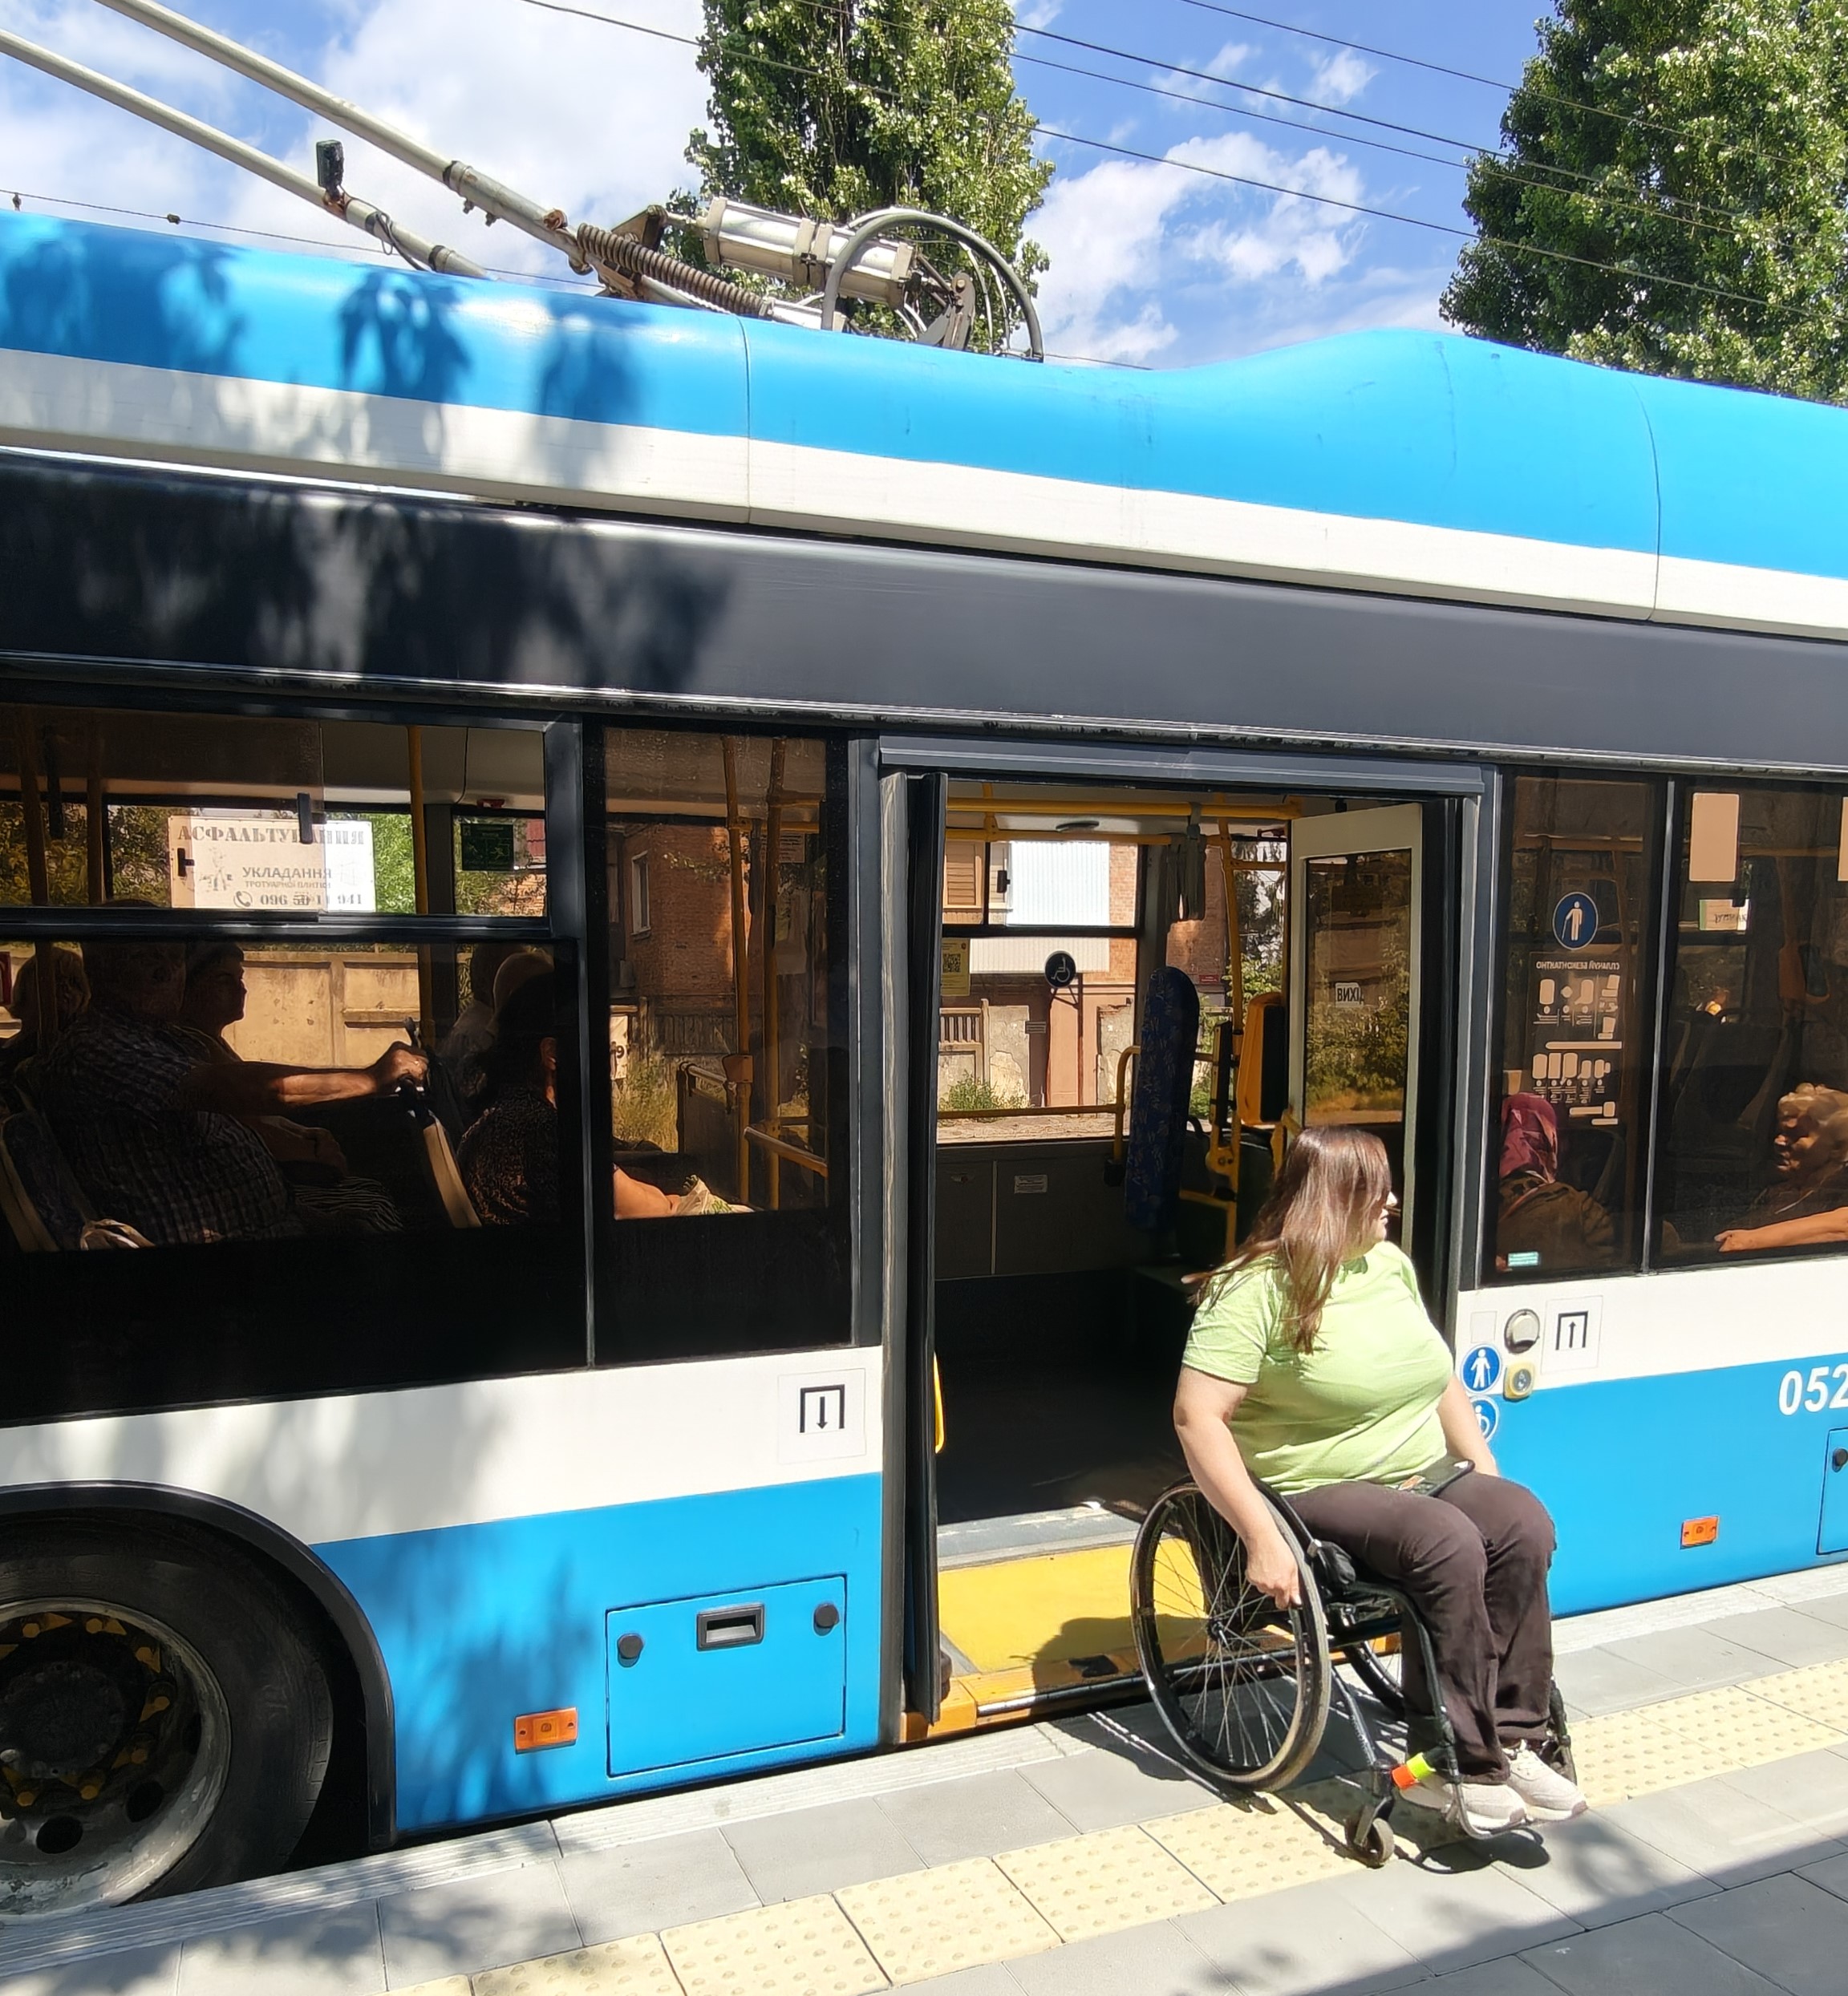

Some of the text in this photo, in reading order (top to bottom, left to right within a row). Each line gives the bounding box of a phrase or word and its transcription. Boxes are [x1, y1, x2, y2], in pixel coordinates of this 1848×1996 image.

[242, 867, 332, 881] УКЛАДАННЯ
[260, 893, 288, 905] 096
[337, 893, 362, 905] 941
[1778, 1363, 1848, 1416] 052
